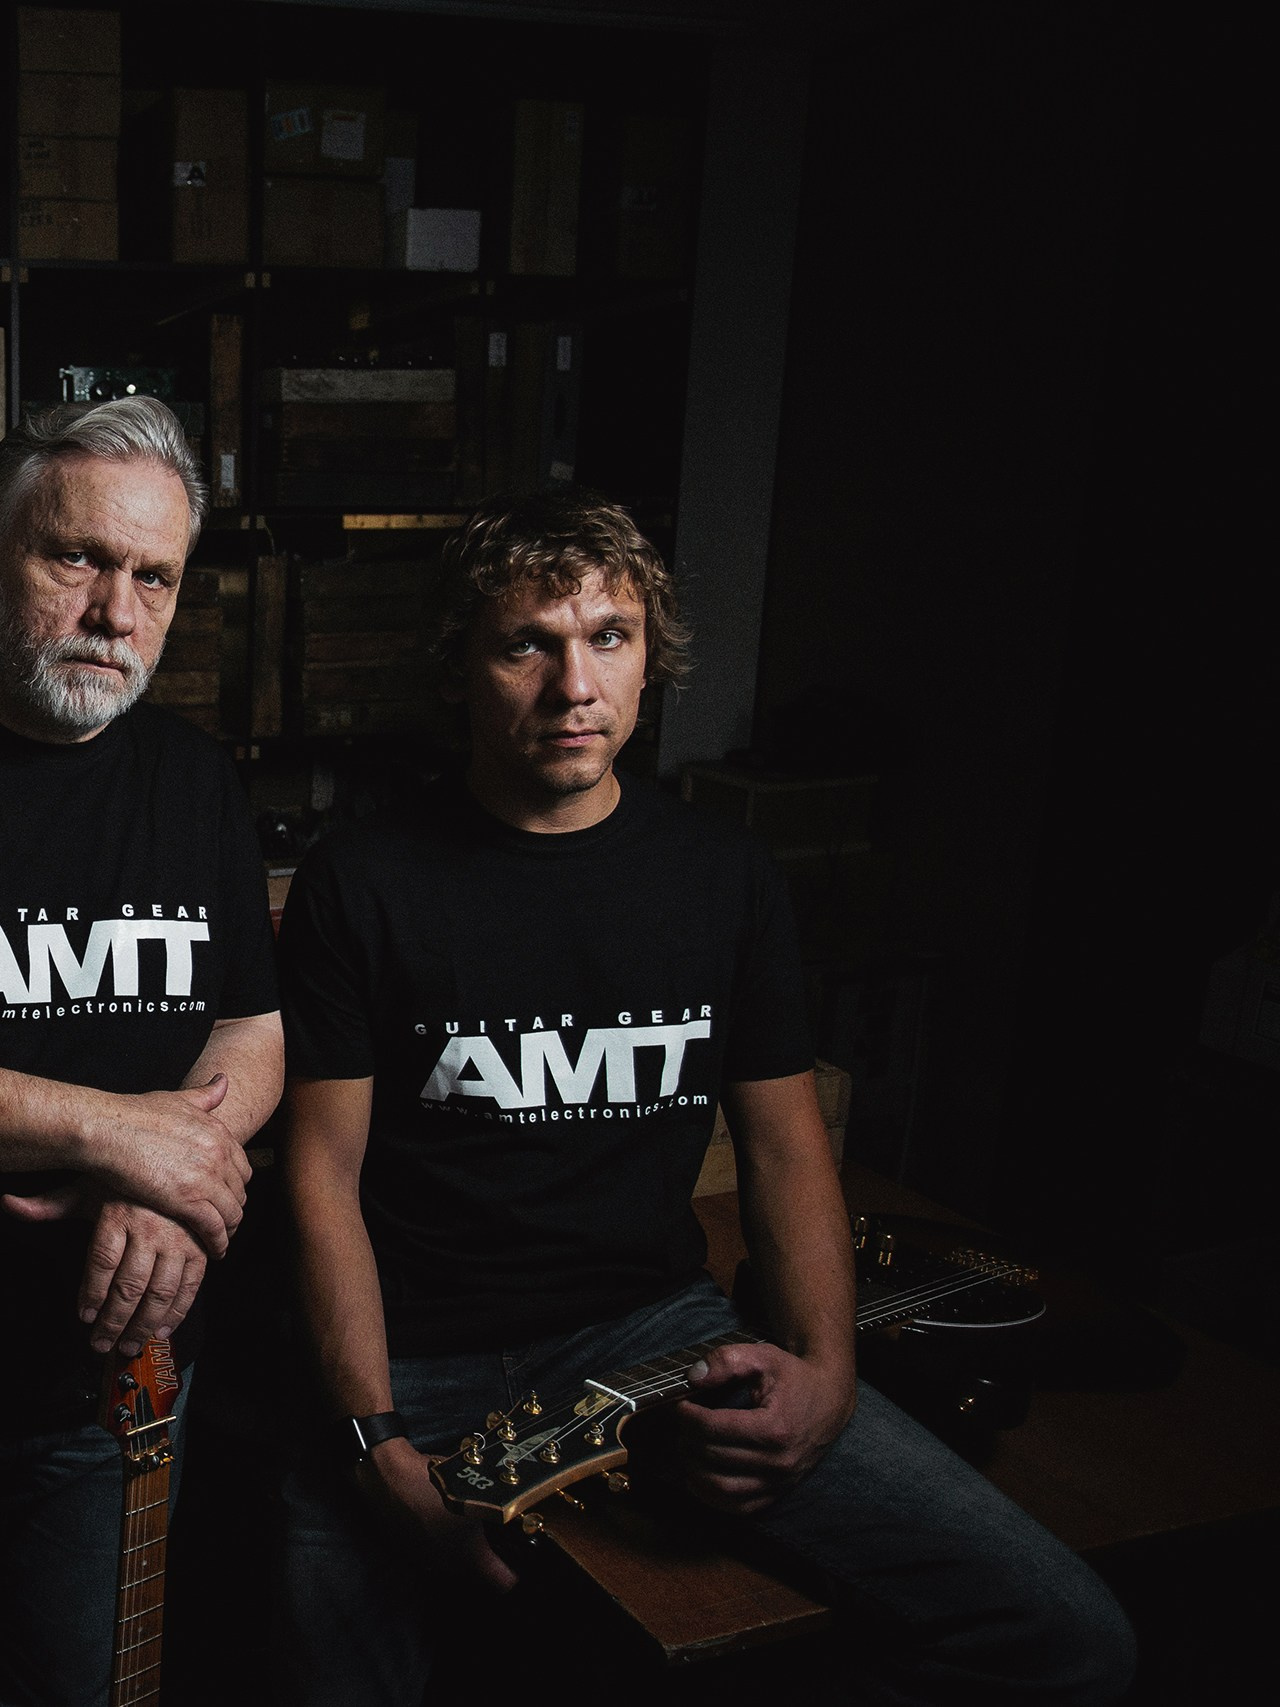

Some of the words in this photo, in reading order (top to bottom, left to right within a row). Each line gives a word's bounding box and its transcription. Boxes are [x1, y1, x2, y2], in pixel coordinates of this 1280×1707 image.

[121, 903, 208, 920] GEAR
[414, 1013, 574, 1036] GUITAR
[617, 1004, 712, 1026] GEAR
[419, 1019, 712, 1110] AMT
